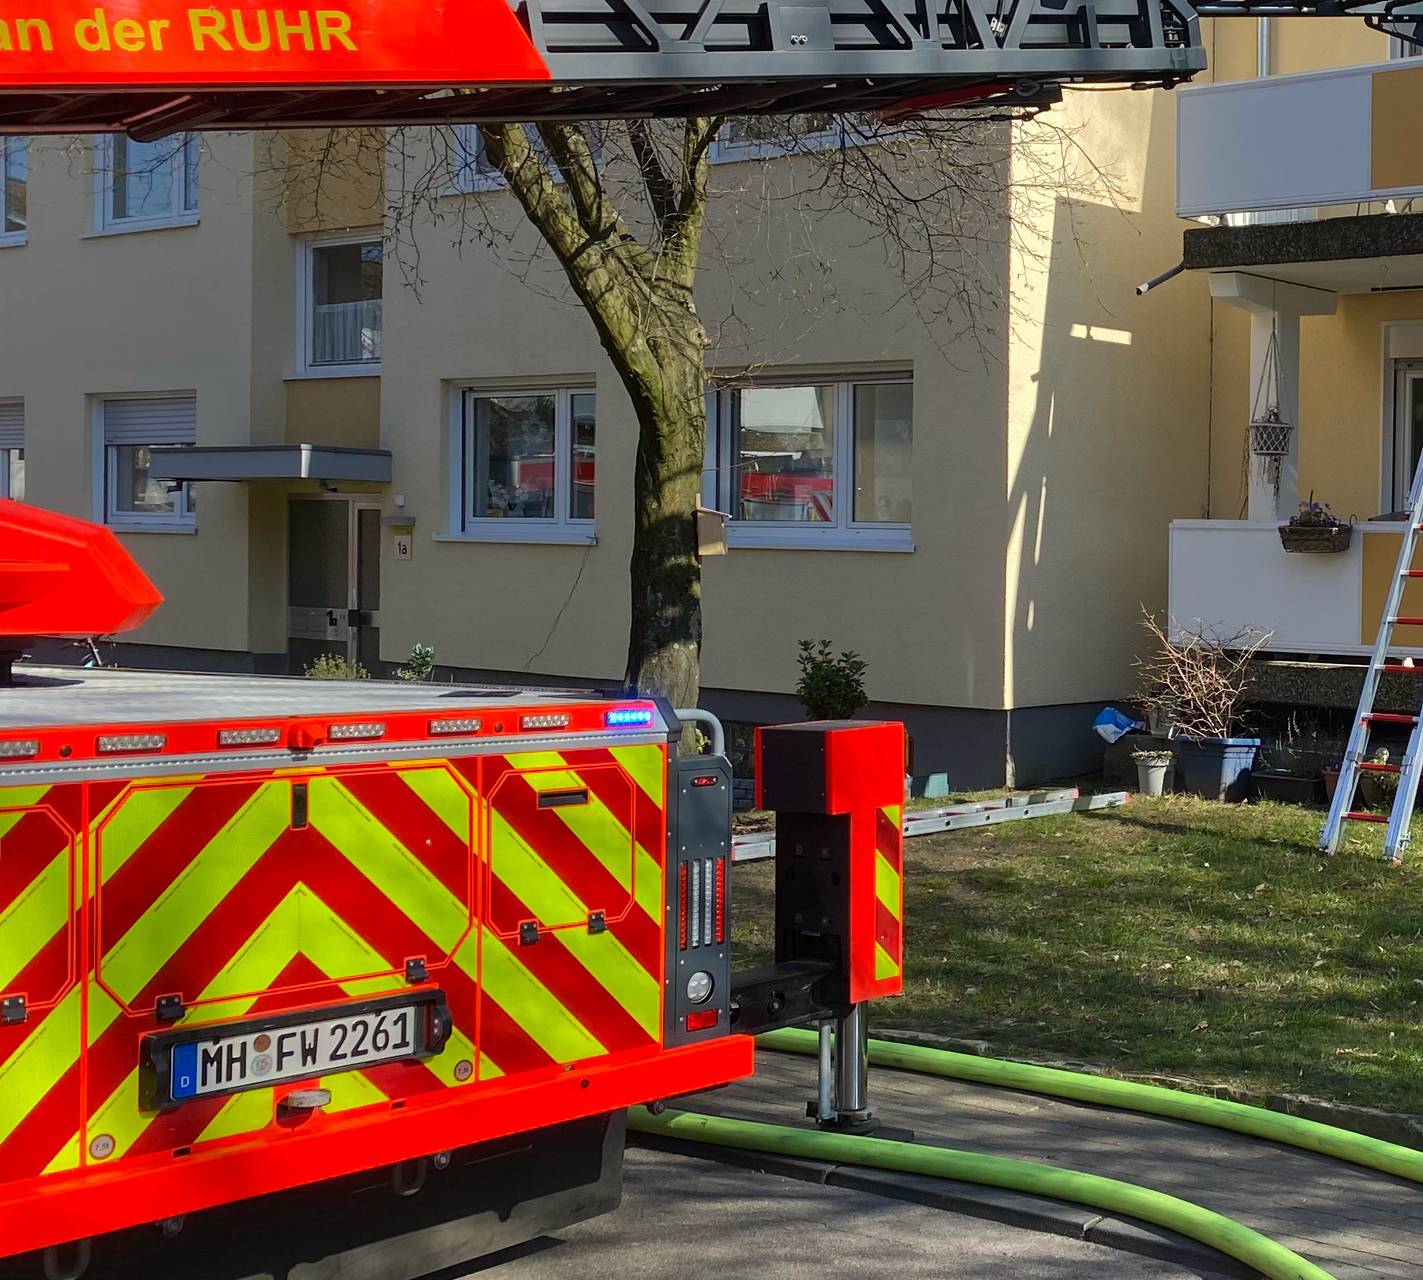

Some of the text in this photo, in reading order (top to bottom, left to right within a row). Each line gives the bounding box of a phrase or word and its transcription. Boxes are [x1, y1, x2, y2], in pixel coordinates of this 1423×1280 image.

[75, 7, 170, 52] der
[188, 8, 359, 51] RUHR
[397, 541, 408, 555] 1a
[200, 1012, 410, 1088] MH FW 2261
[179, 1075, 191, 1089] D
